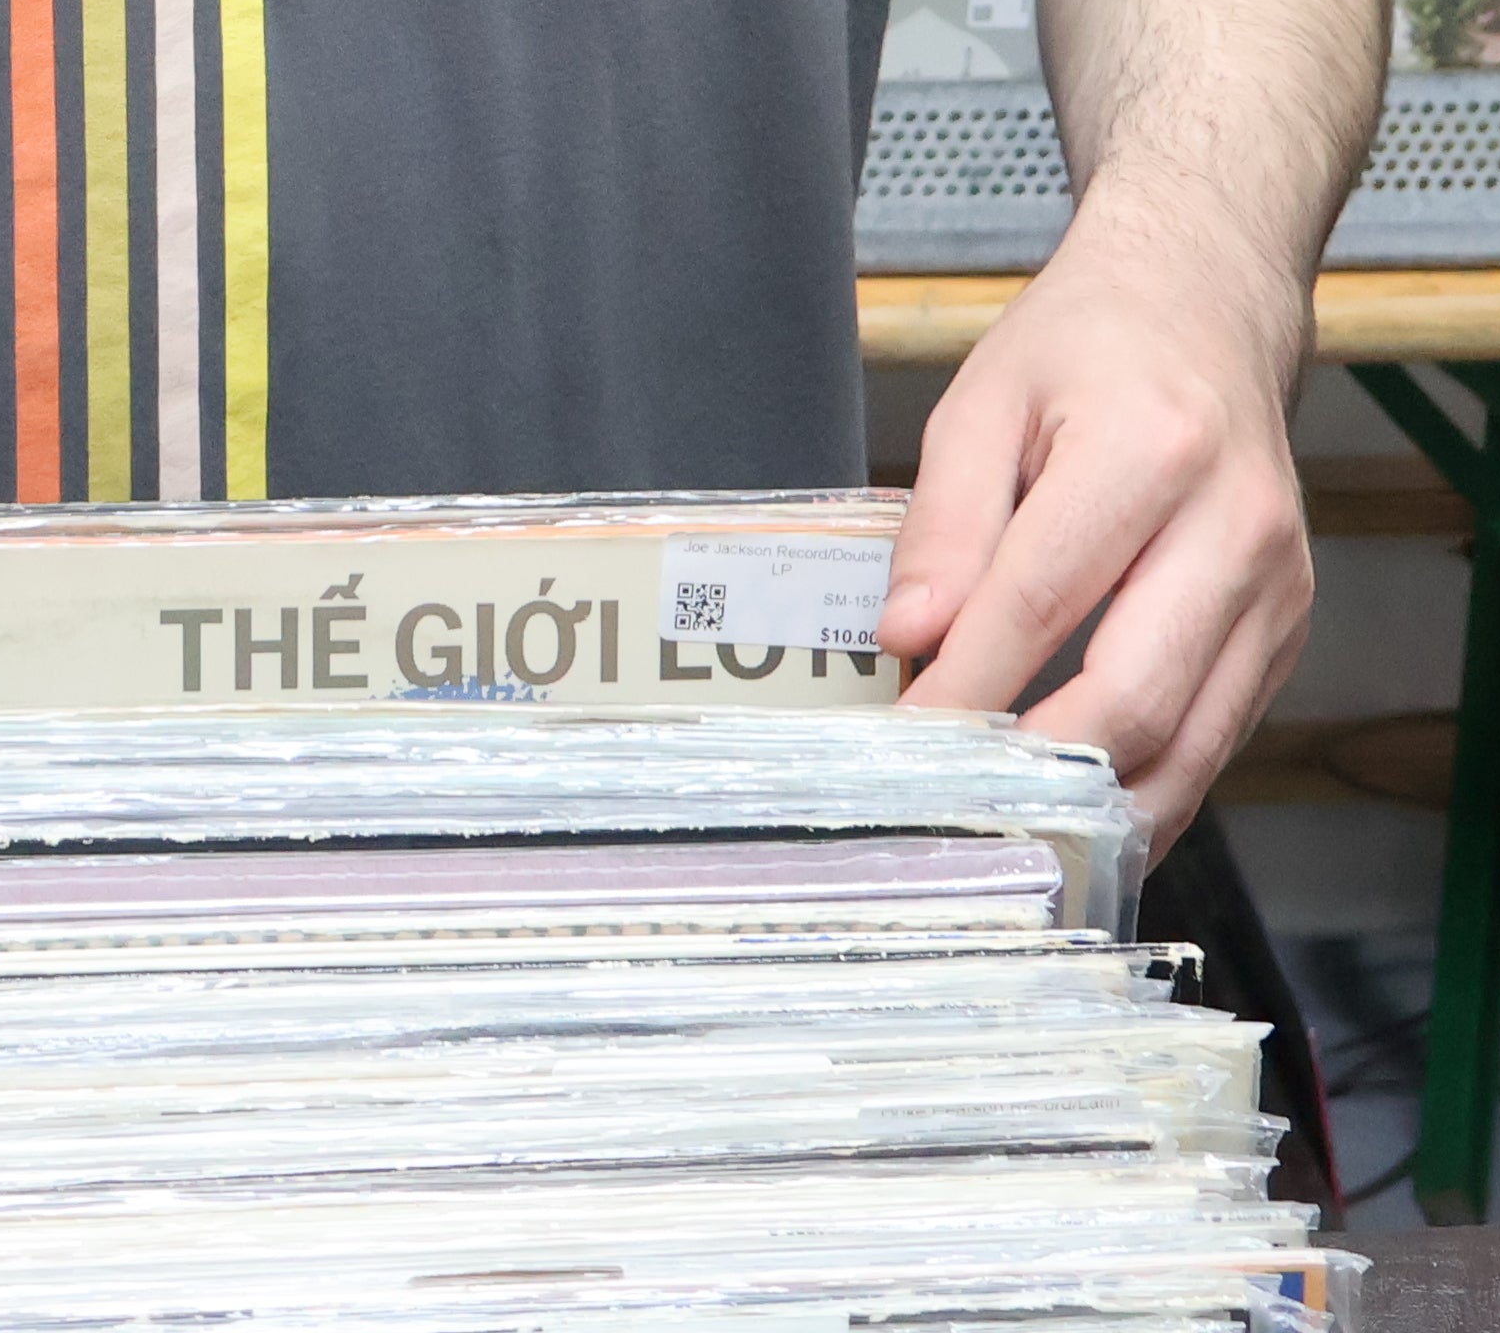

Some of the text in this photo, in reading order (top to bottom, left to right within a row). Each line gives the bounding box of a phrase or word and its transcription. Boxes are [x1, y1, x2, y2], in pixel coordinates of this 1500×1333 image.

[682, 539, 884, 568] Joe Jackson Record/Double
[770, 566, 794, 586] LP
[822, 592, 889, 614] SM-157
[158, 572, 369, 694] THẾ
[394, 576, 621, 690] GIỚI
